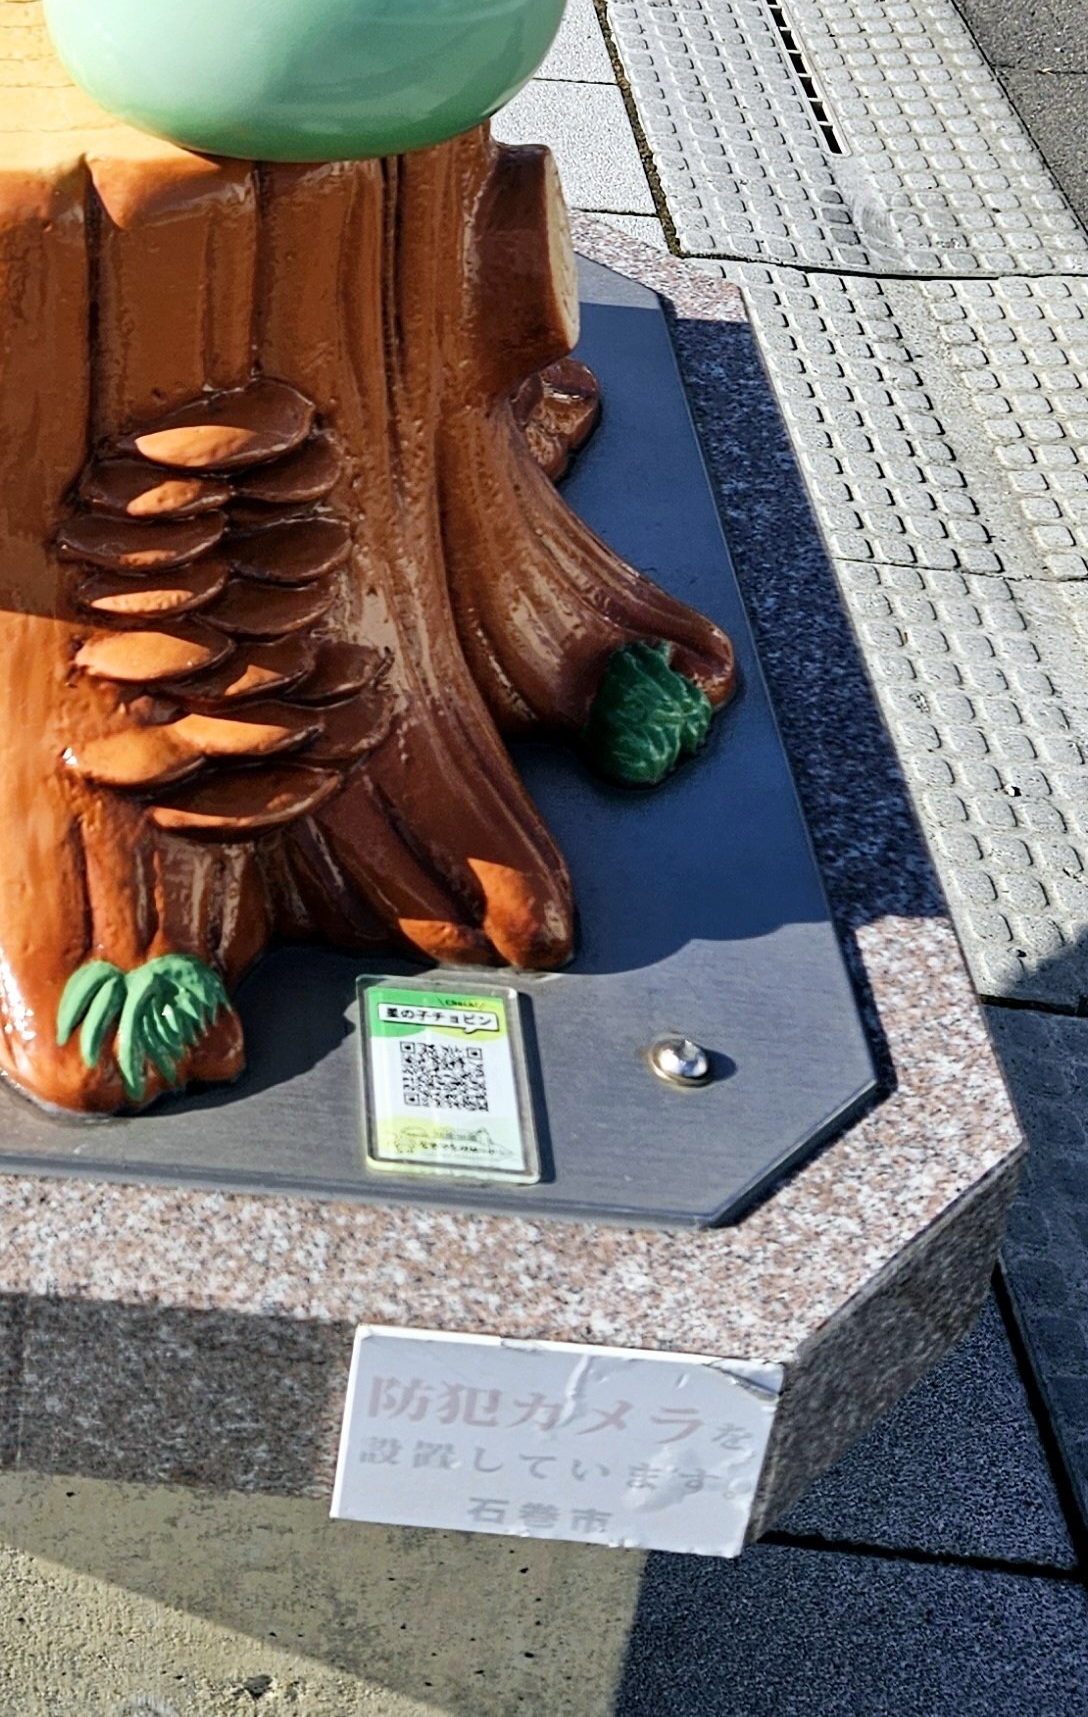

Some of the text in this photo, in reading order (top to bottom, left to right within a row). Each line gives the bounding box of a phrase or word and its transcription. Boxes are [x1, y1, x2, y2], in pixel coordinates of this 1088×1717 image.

[386, 1007, 492, 1026] 星の子チョビン
[467, 1496, 613, 1533] 石巻市
